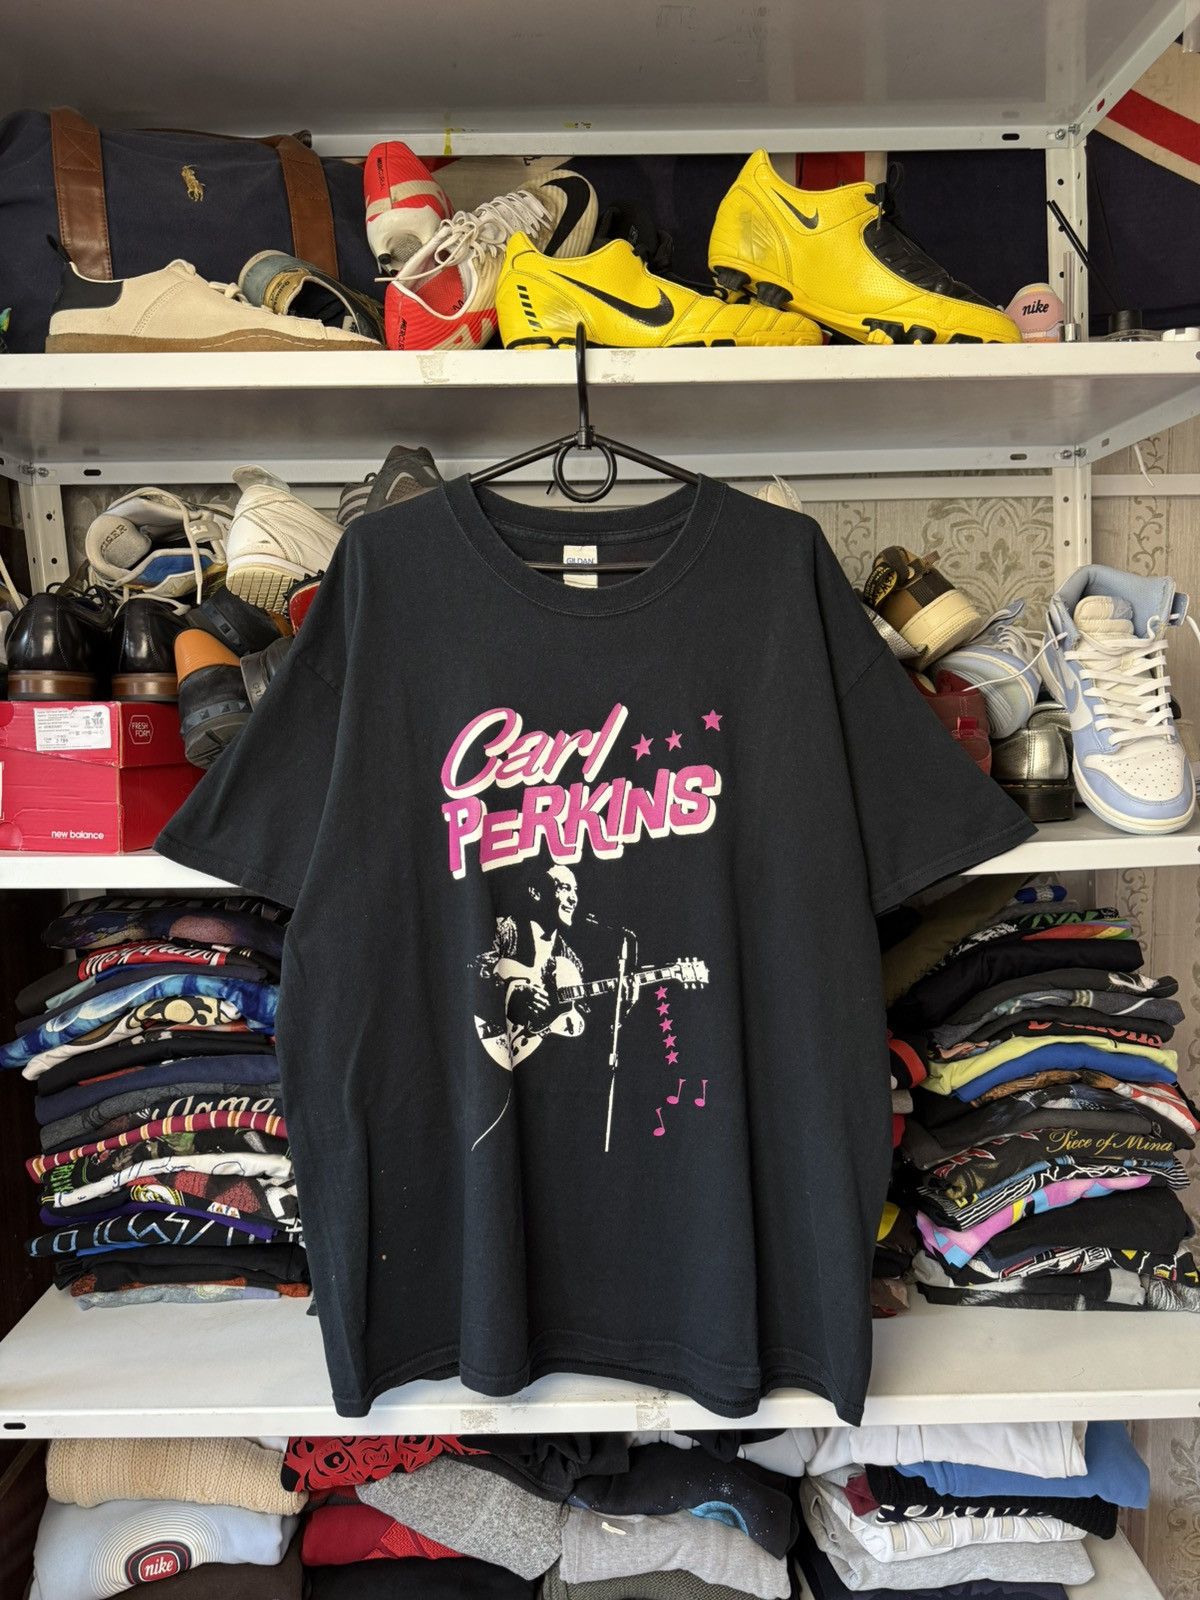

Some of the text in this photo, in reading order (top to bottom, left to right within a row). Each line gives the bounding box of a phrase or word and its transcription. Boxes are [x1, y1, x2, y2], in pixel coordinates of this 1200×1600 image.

[1022, 299, 1050, 316] nike
[131, 721, 149, 730] FRESH
[440, 702, 628, 799] Carl
[441, 764, 722, 880] PERKINS
[51, 829, 105, 840] new balance
[1046, 1129, 1093, 1153] Piece
[1095, 1132, 1120, 1155] of
[144, 1556, 174, 1577] nike
